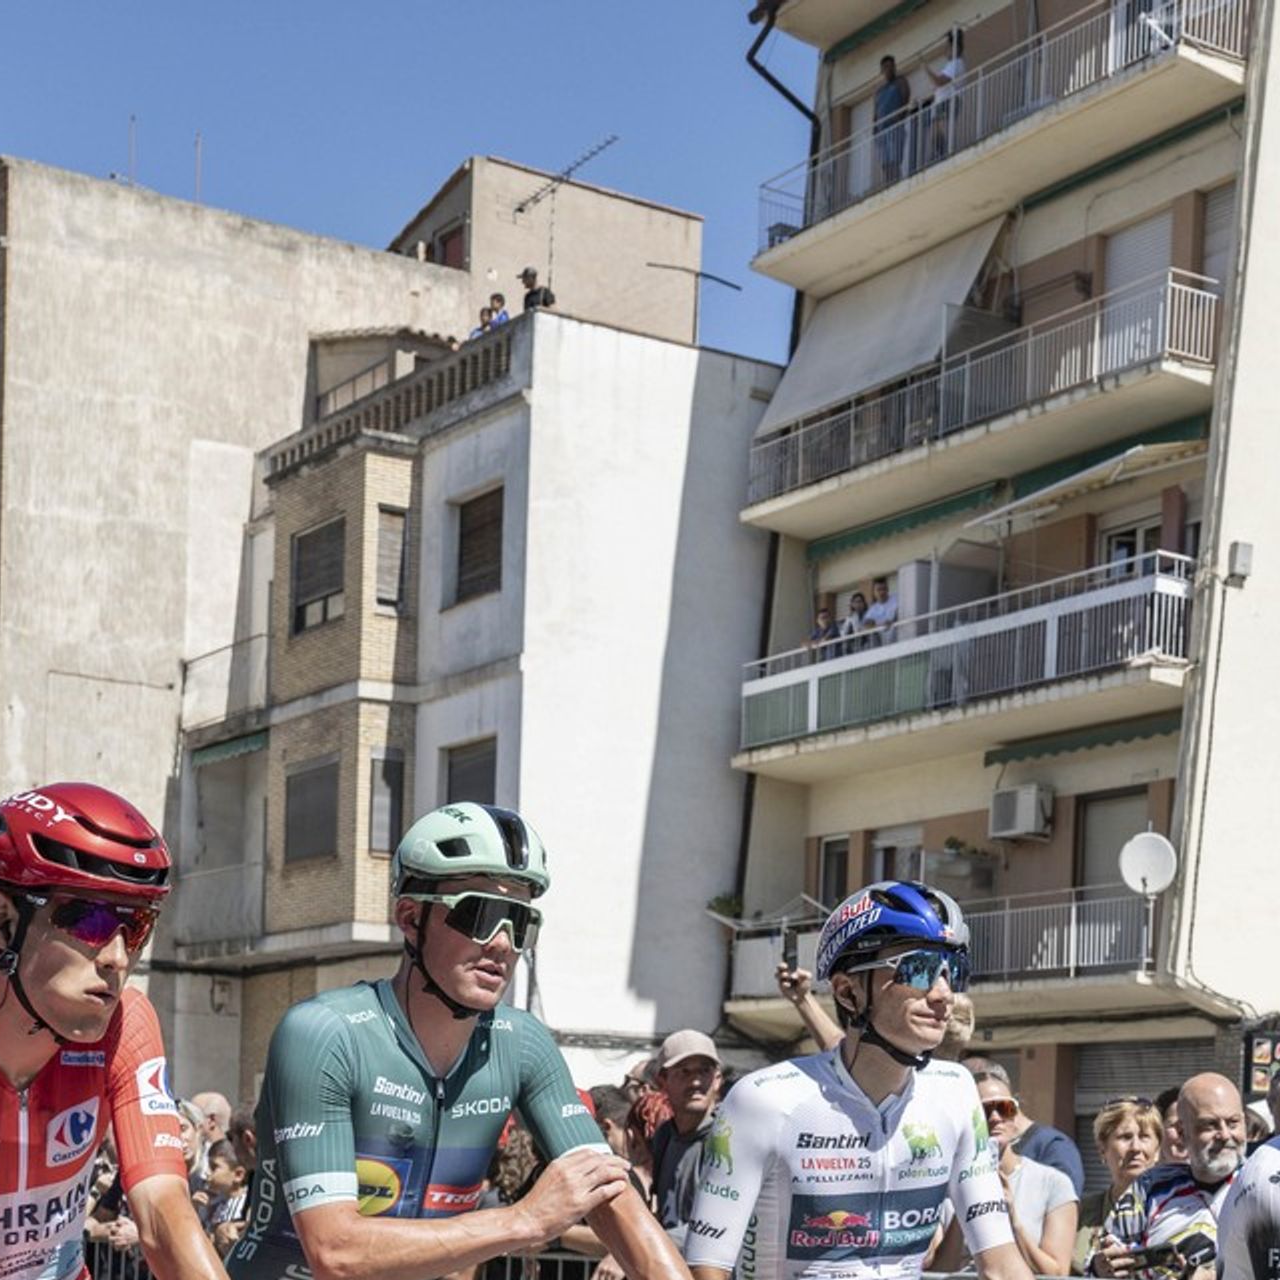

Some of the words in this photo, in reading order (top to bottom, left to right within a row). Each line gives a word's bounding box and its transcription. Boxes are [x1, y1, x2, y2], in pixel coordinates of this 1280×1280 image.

[373, 1076, 427, 1104] Santini
[273, 1122, 324, 1144] antini
[796, 1132, 872, 1149] Santini
[802, 1158, 815, 1169] LA
[816, 1157, 856, 1169] VUELTA
[858, 1156, 872, 1169] 25
[287, 1182, 326, 1202] ODA
[791, 1231, 834, 1247] Red
[836, 1230, 880, 1247] Bull
